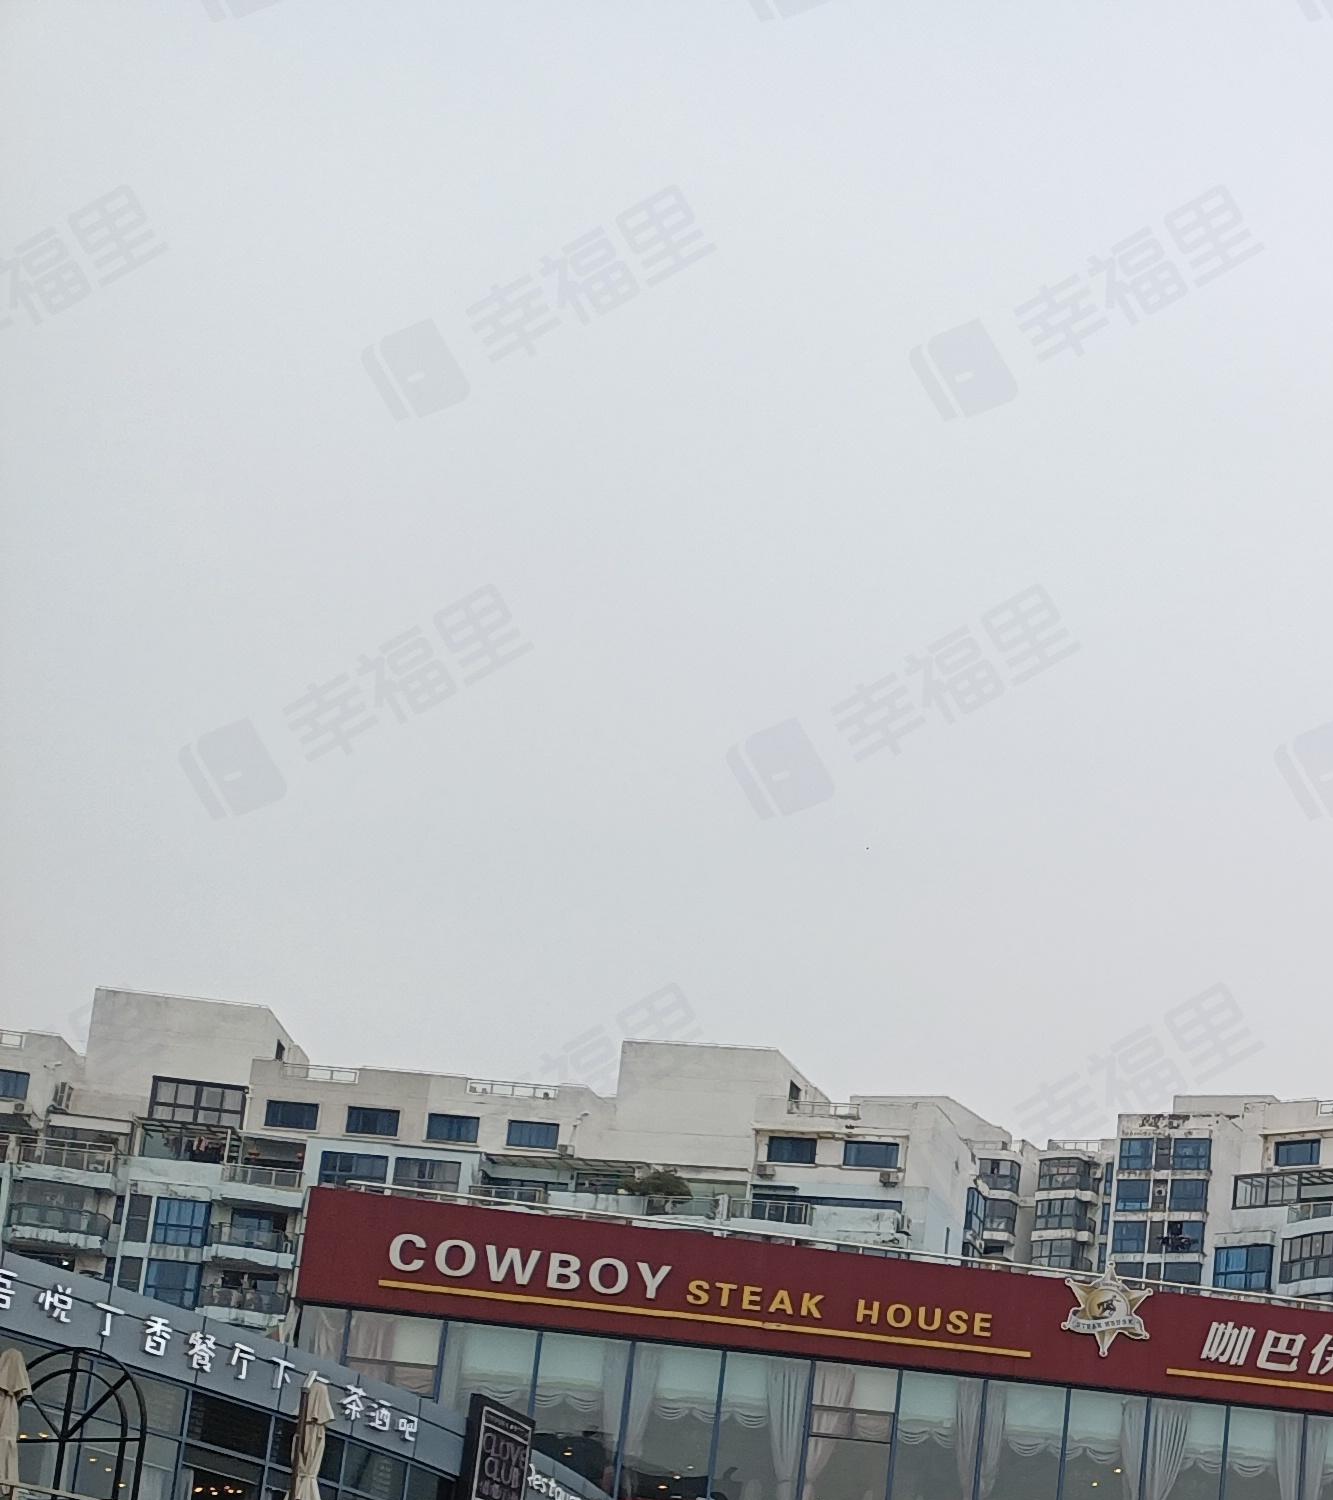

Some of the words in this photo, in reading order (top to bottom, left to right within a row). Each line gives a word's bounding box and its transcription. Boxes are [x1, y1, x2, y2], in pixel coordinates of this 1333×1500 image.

[388, 1233, 671, 1300] COWBOY
[687, 1279, 824, 1319] STEAK
[856, 1298, 993, 1337] HOUSE
